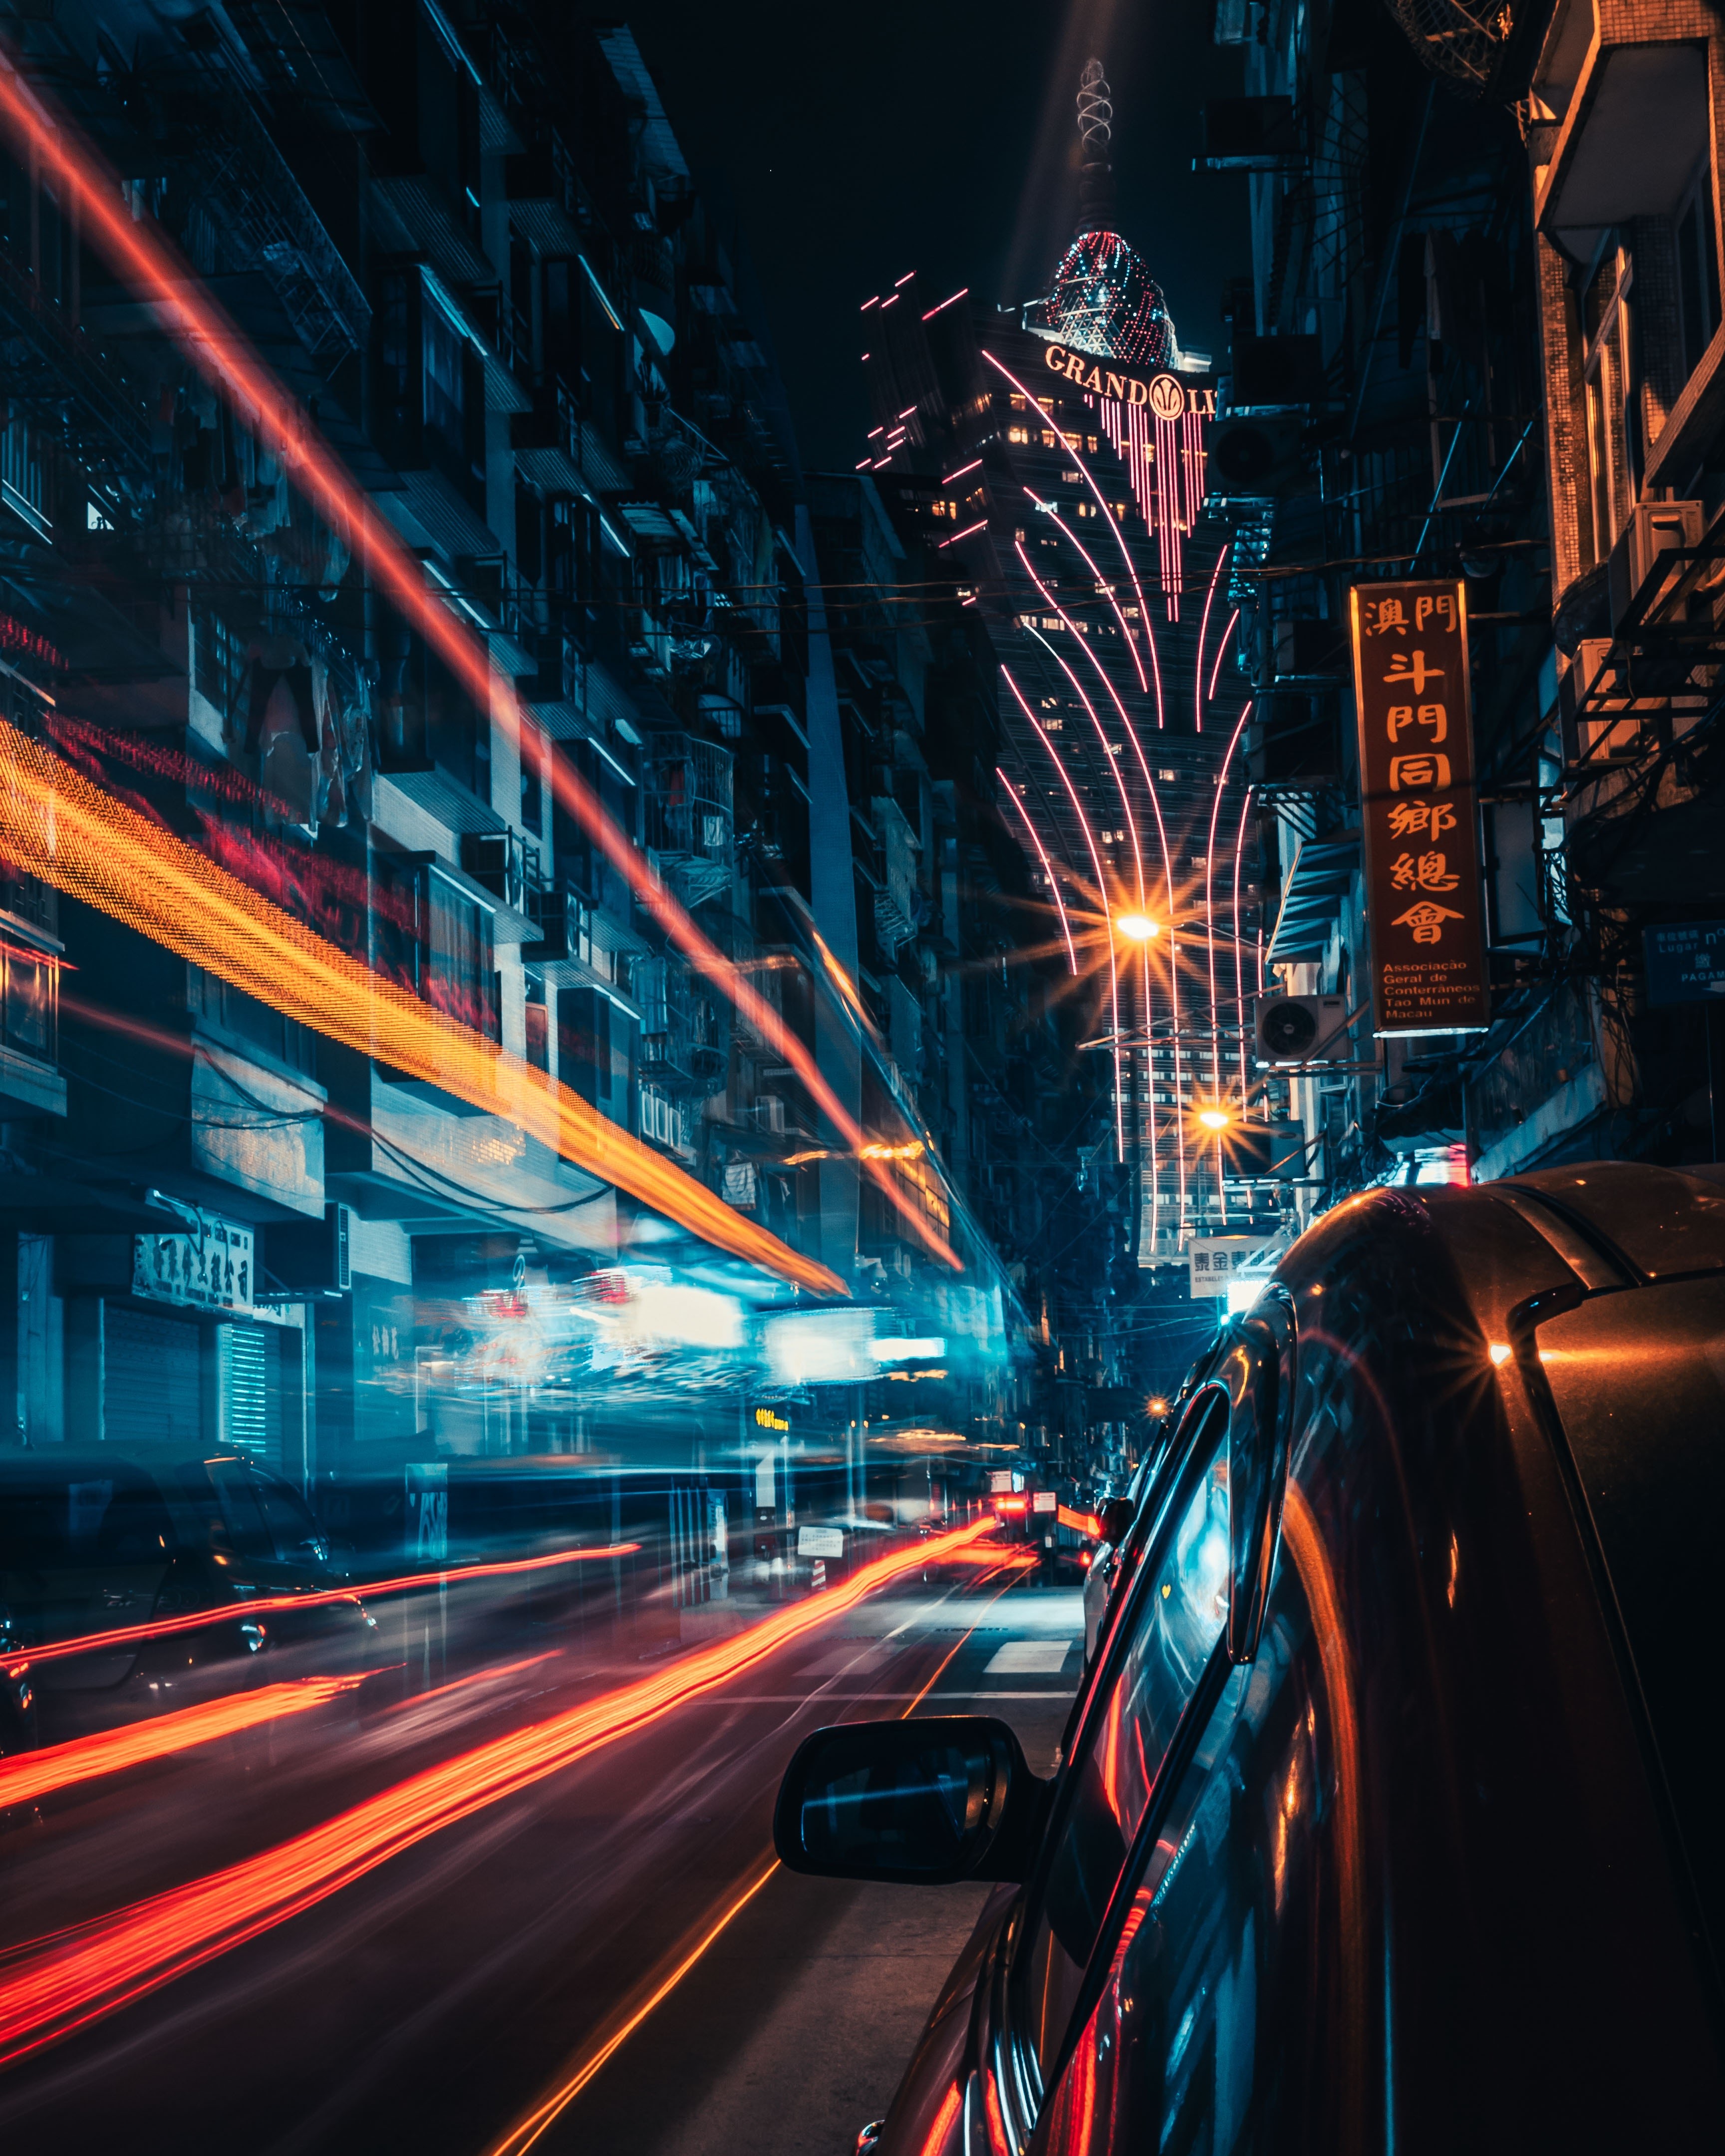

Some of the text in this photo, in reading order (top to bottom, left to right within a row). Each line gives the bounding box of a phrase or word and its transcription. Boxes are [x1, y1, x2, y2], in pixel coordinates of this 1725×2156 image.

[1045, 345, 1218, 414] GRAND LI
[1365, 594, 1457, 637] 澳門
[1383, 650, 1465, 945] 斗門同鄉總會
[1659, 942, 1698, 953] Lugar
[1384, 973, 1447, 984] Geral de
[1681, 970, 1725, 982] PAGAM
[1385, 995, 1475, 1007] Tao Mun de
[1386, 1010, 1433, 1019] Macau
